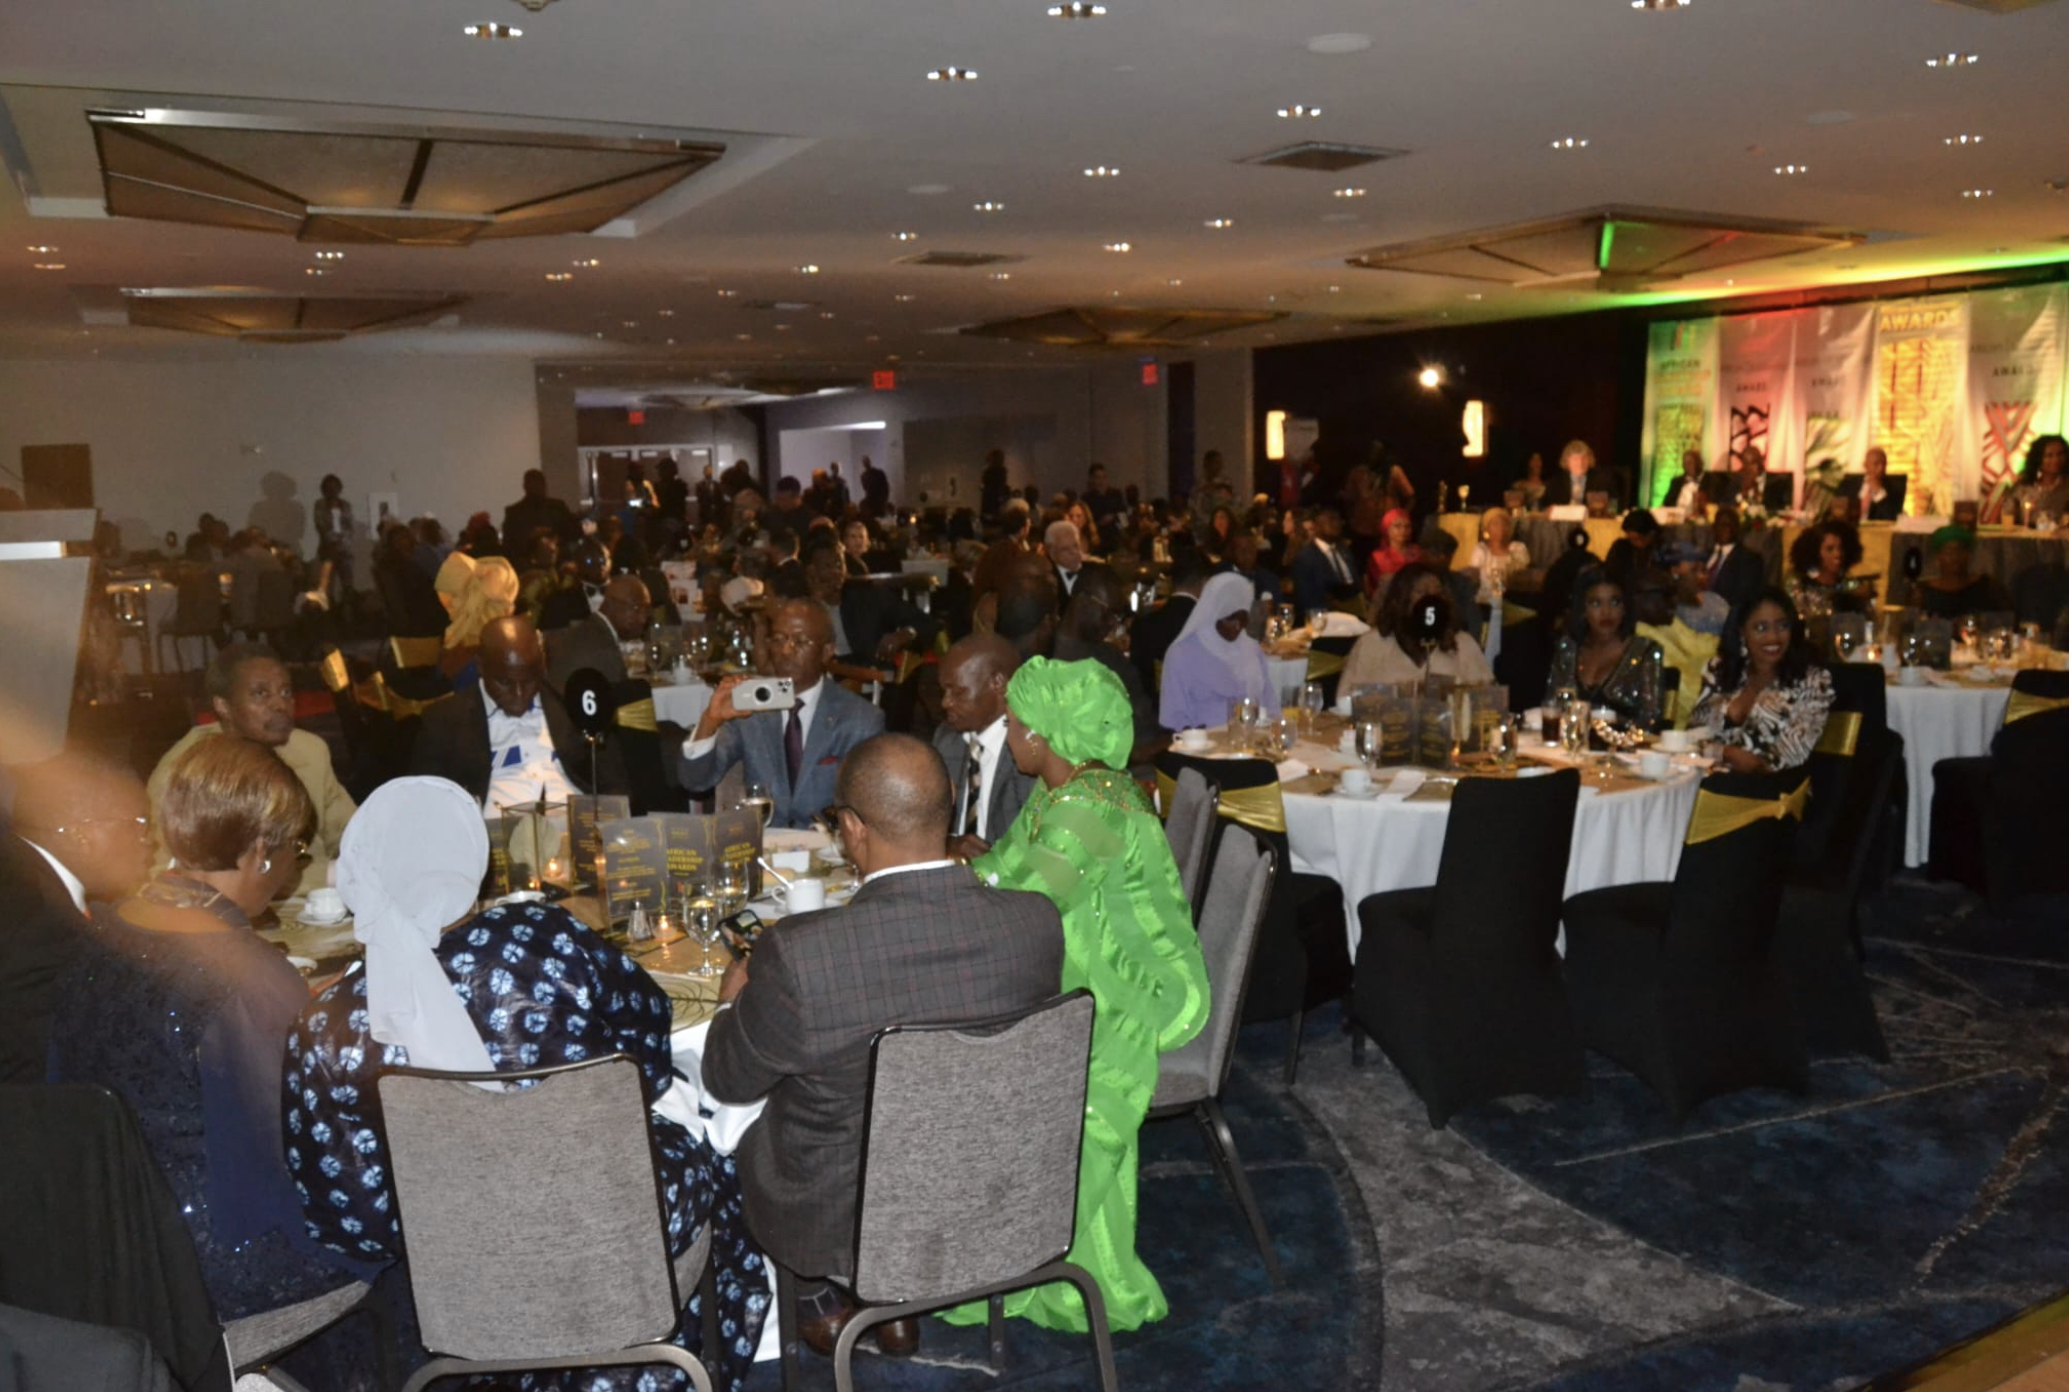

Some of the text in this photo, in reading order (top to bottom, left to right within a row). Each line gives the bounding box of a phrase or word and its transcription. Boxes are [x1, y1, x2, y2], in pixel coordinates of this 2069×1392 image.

[1879, 309, 1959, 331] AWARDS
[1424, 606, 1436, 626] 5
[582, 689, 597, 716] 6
